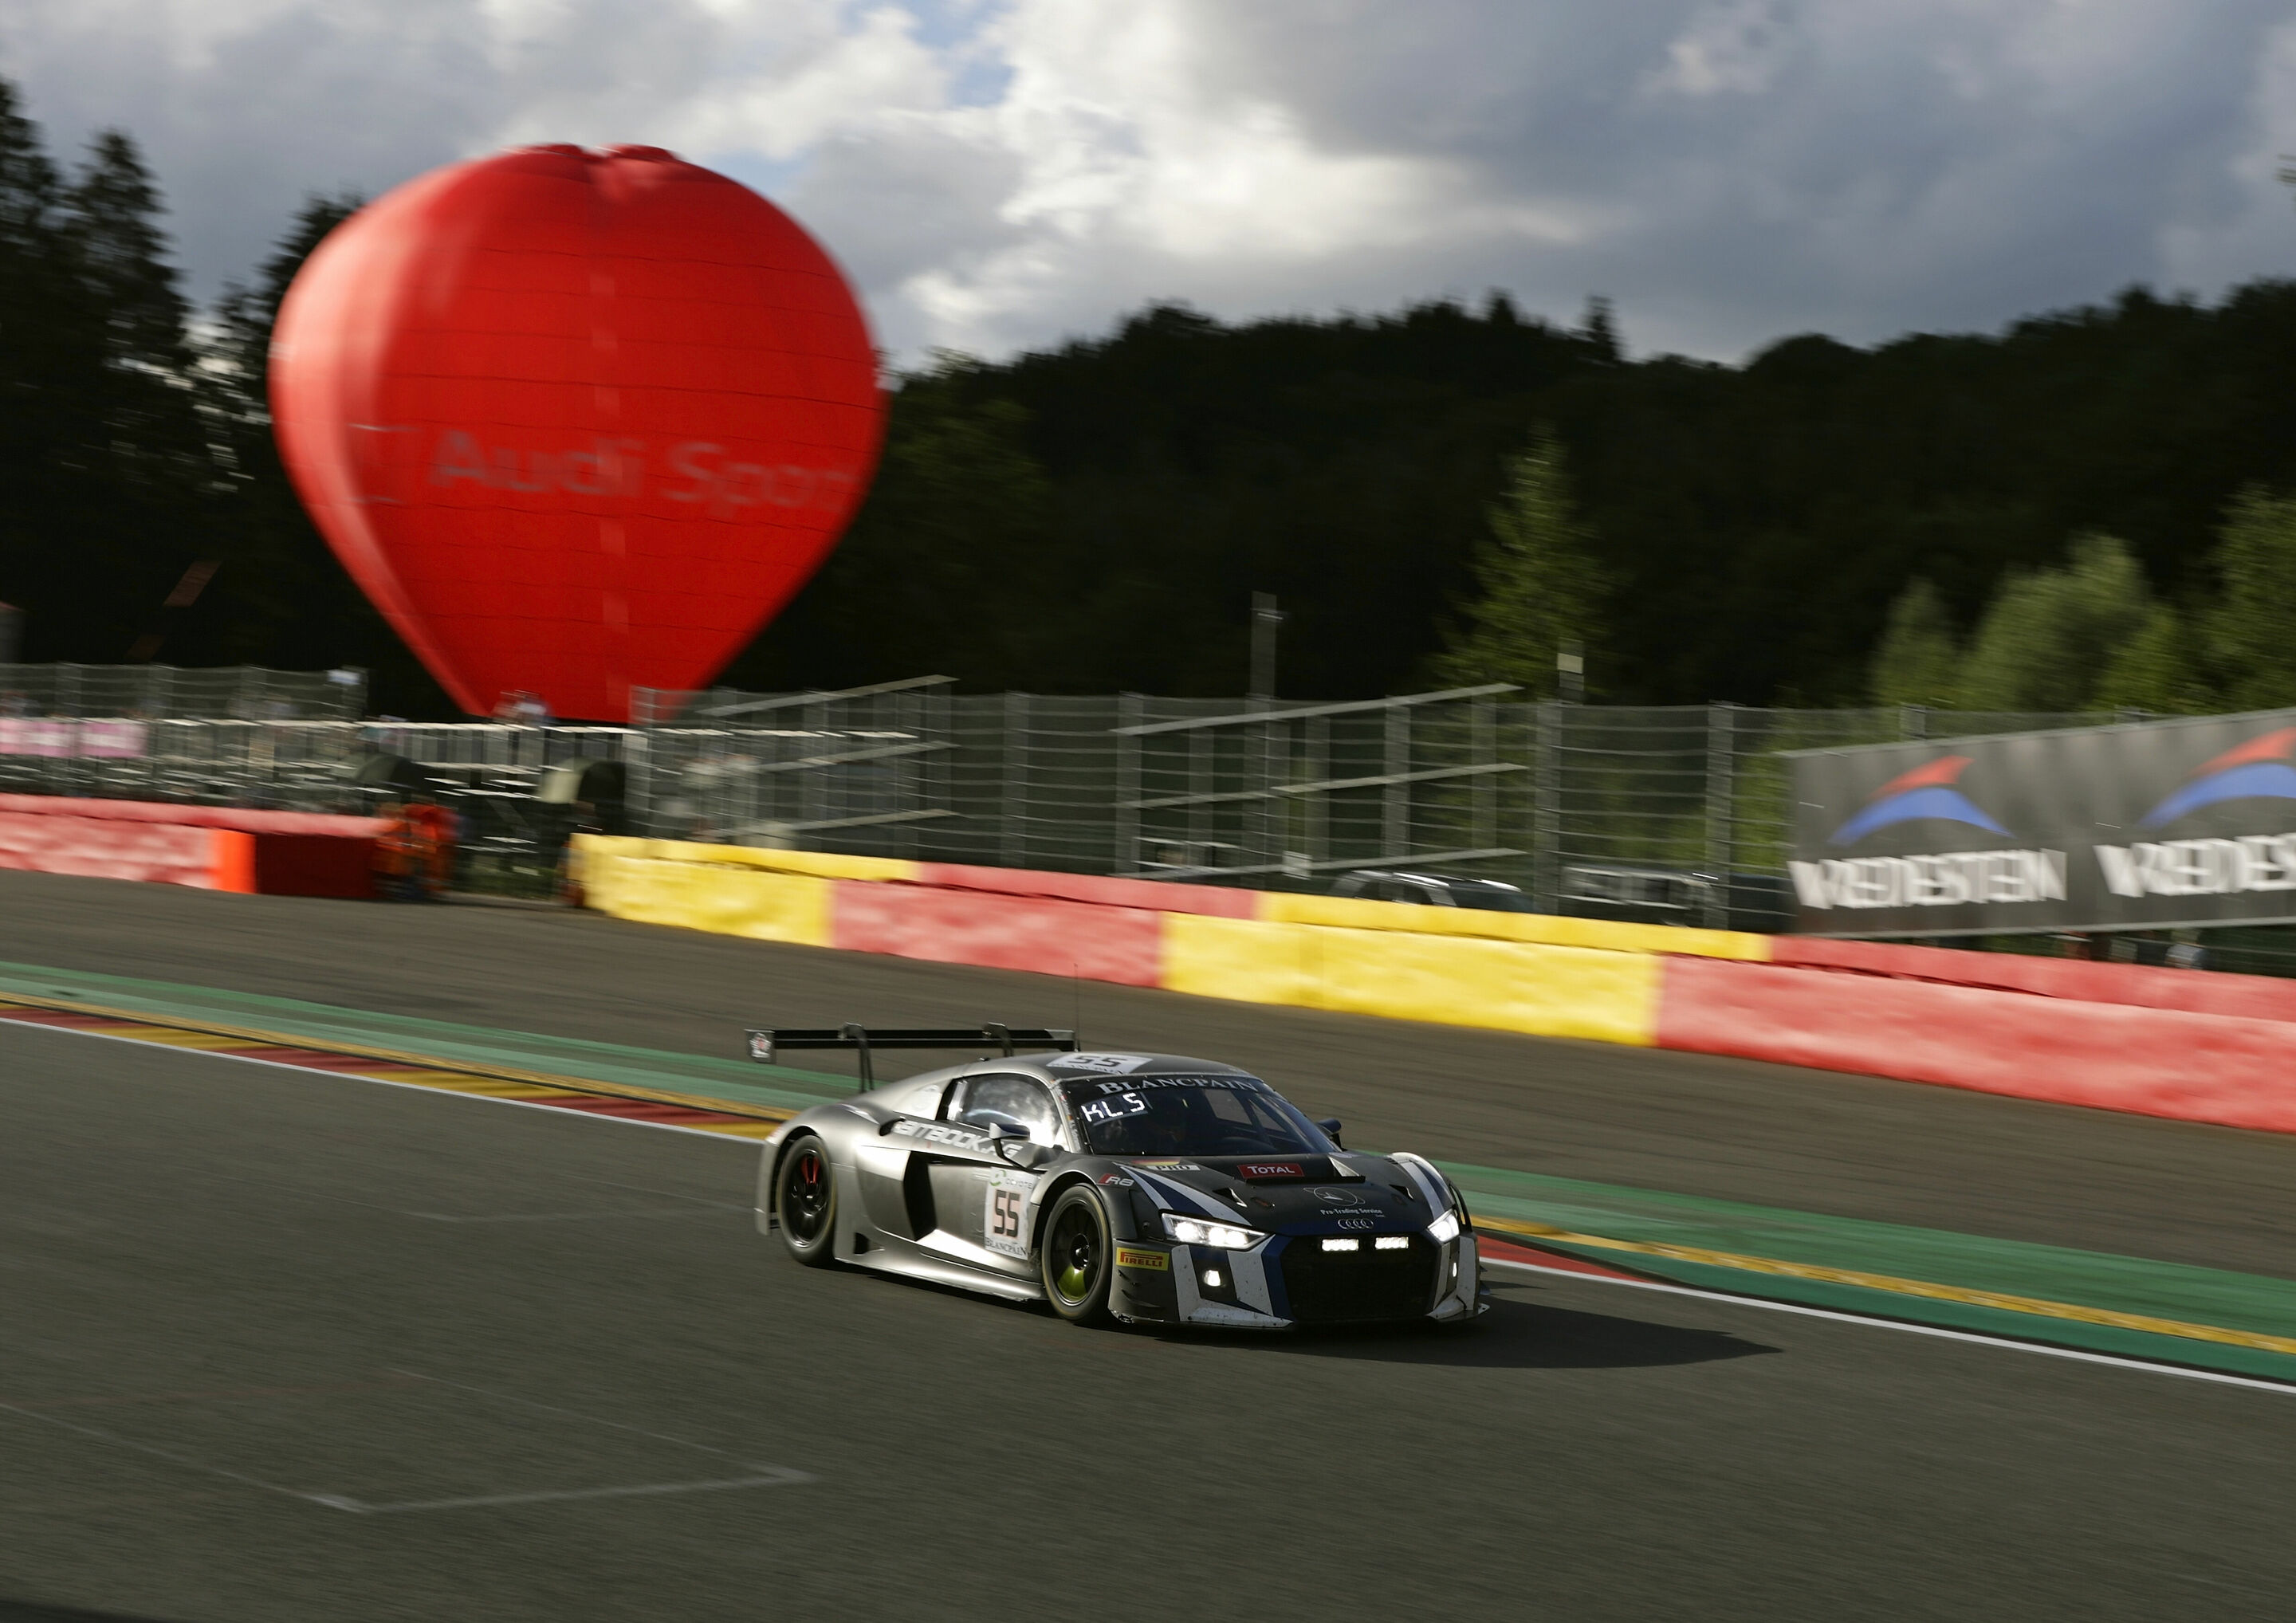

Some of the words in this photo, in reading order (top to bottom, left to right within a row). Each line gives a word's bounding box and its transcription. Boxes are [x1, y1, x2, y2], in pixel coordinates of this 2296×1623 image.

[426, 429, 647, 498] Audi
[1068, 1055, 1127, 1067] 55
[1097, 1078, 1259, 1094] BLANCPAIN
[1248, 1165, 1295, 1174] TOTAL
[1104, 1175, 1135, 1187] R8
[993, 1189, 1020, 1238] 55
[1120, 1252, 1163, 1267] PIRELLI
